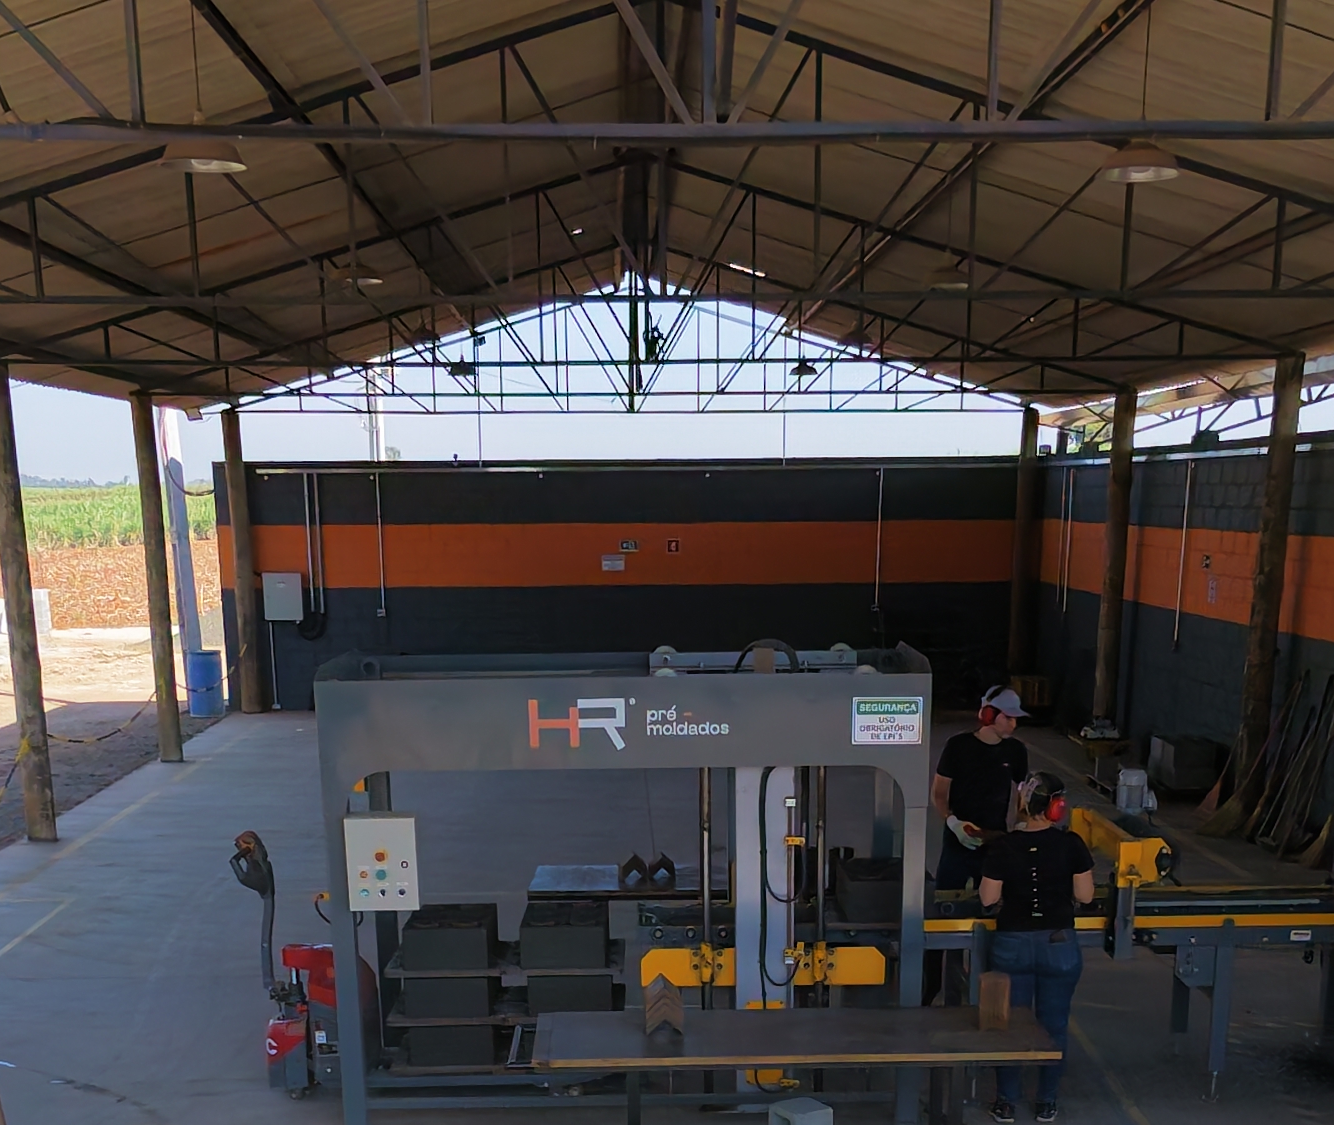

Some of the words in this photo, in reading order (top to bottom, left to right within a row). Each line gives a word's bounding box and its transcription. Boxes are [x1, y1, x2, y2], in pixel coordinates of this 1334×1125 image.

[646, 705, 676, 722] pré
[528, 698, 626, 750] HR
[646, 721, 730, 736] moldados
